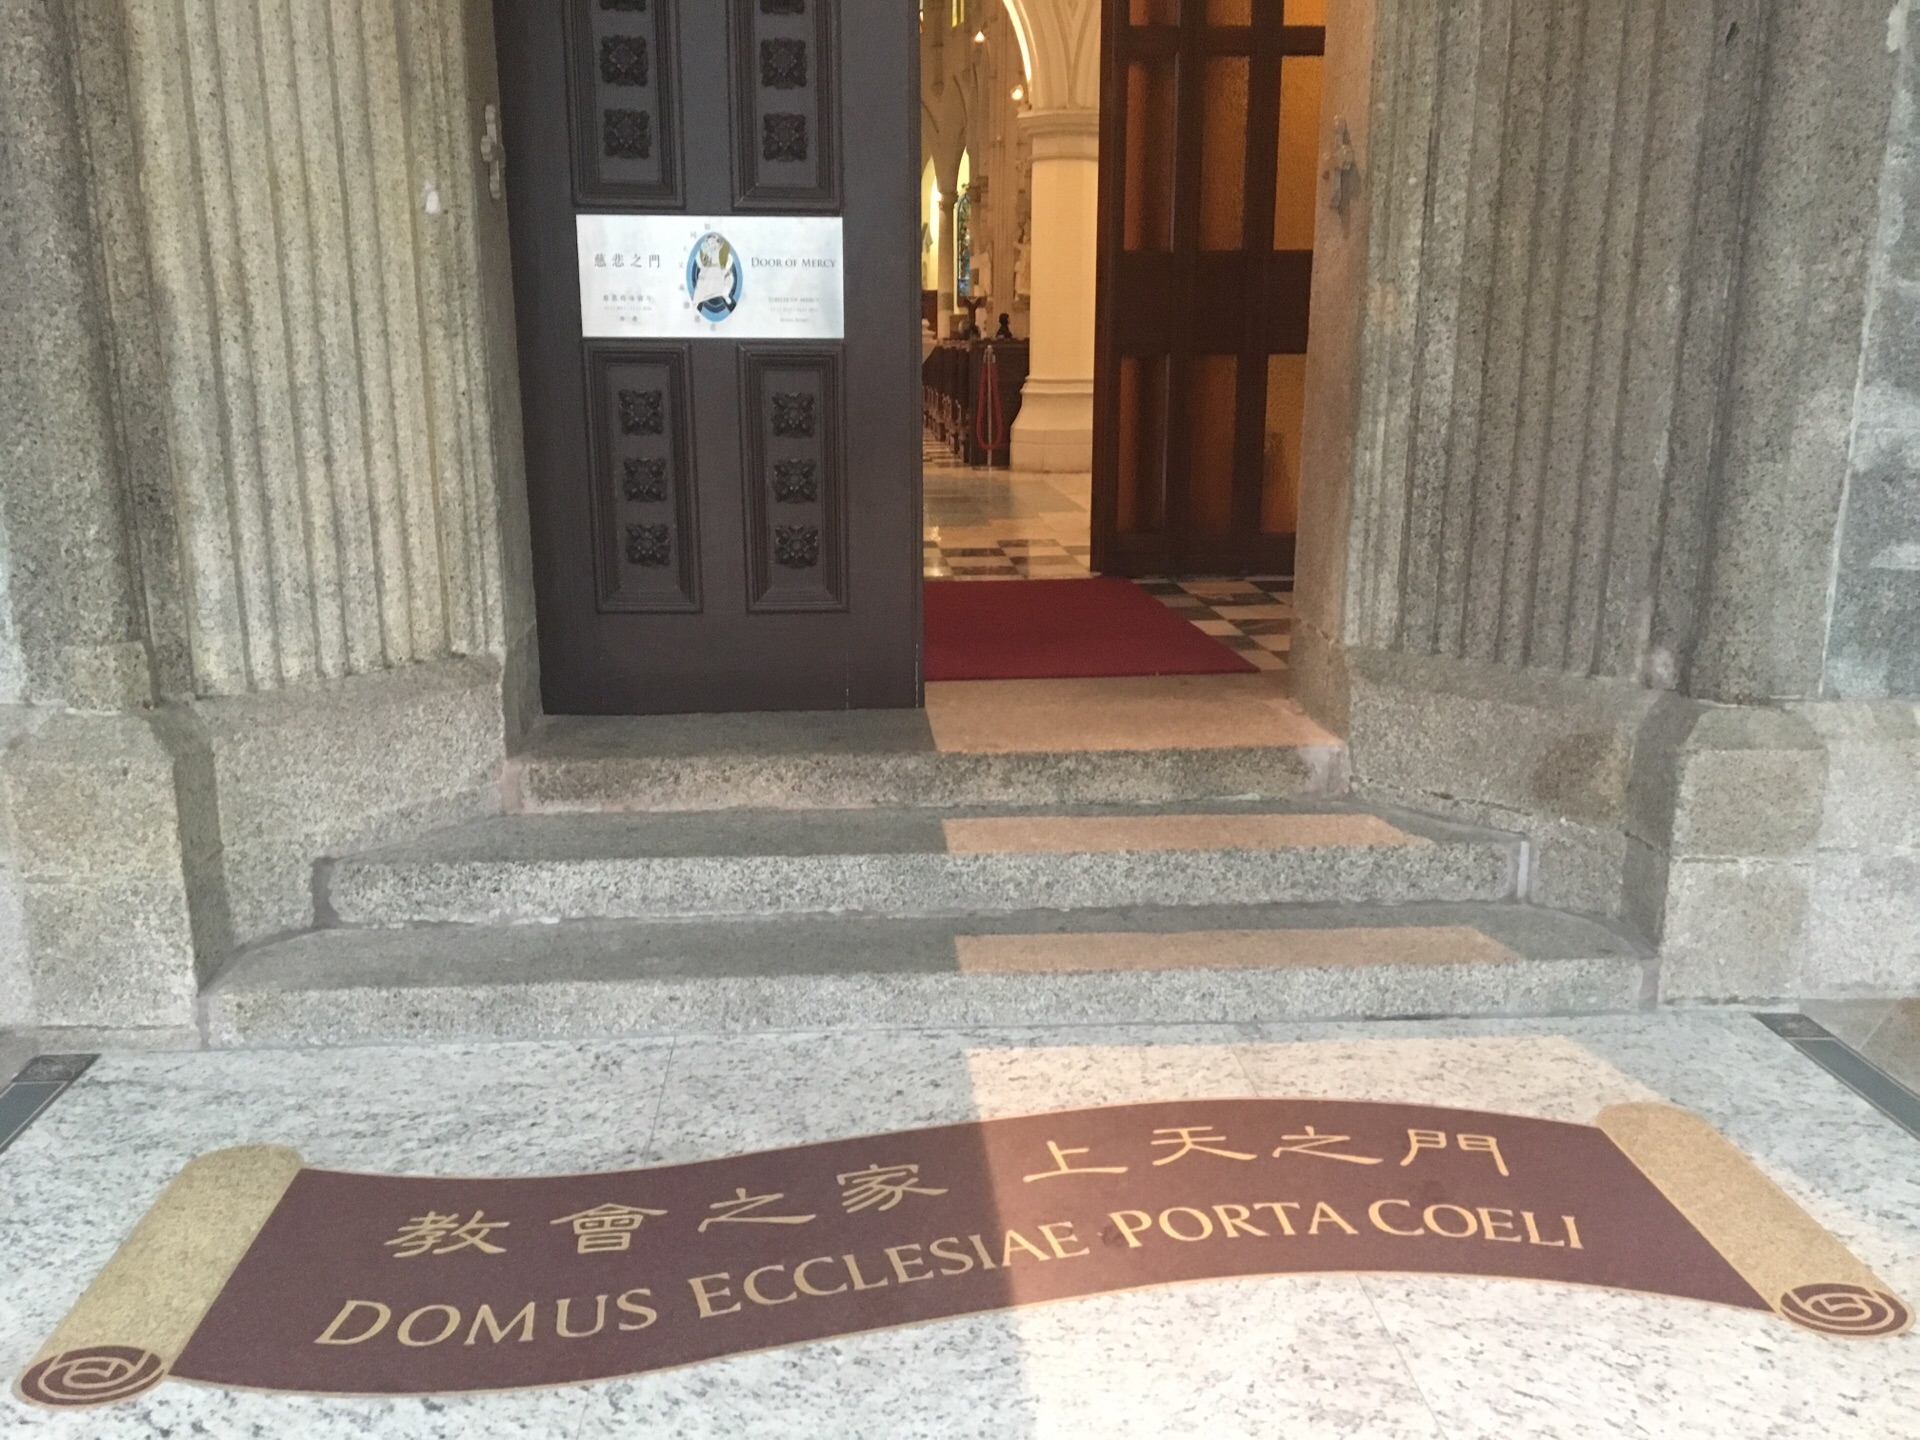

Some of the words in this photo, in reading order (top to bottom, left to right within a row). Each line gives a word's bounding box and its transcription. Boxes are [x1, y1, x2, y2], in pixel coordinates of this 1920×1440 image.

[594, 253, 660, 268] 慈悲之門
[751, 257, 783, 268] DOOR
[785, 258, 798, 268] OF
[802, 258, 837, 268] MERCY
[384, 1164, 948, 1257] 教會之家
[1023, 1126, 1509, 1182] 上天之門
[314, 1288, 657, 1346] DOMUS
[688, 1222, 1090, 1318] ECCLESIAE
[1108, 1202, 1358, 1249] PORTA
[1368, 1199, 1583, 1250] COELI
